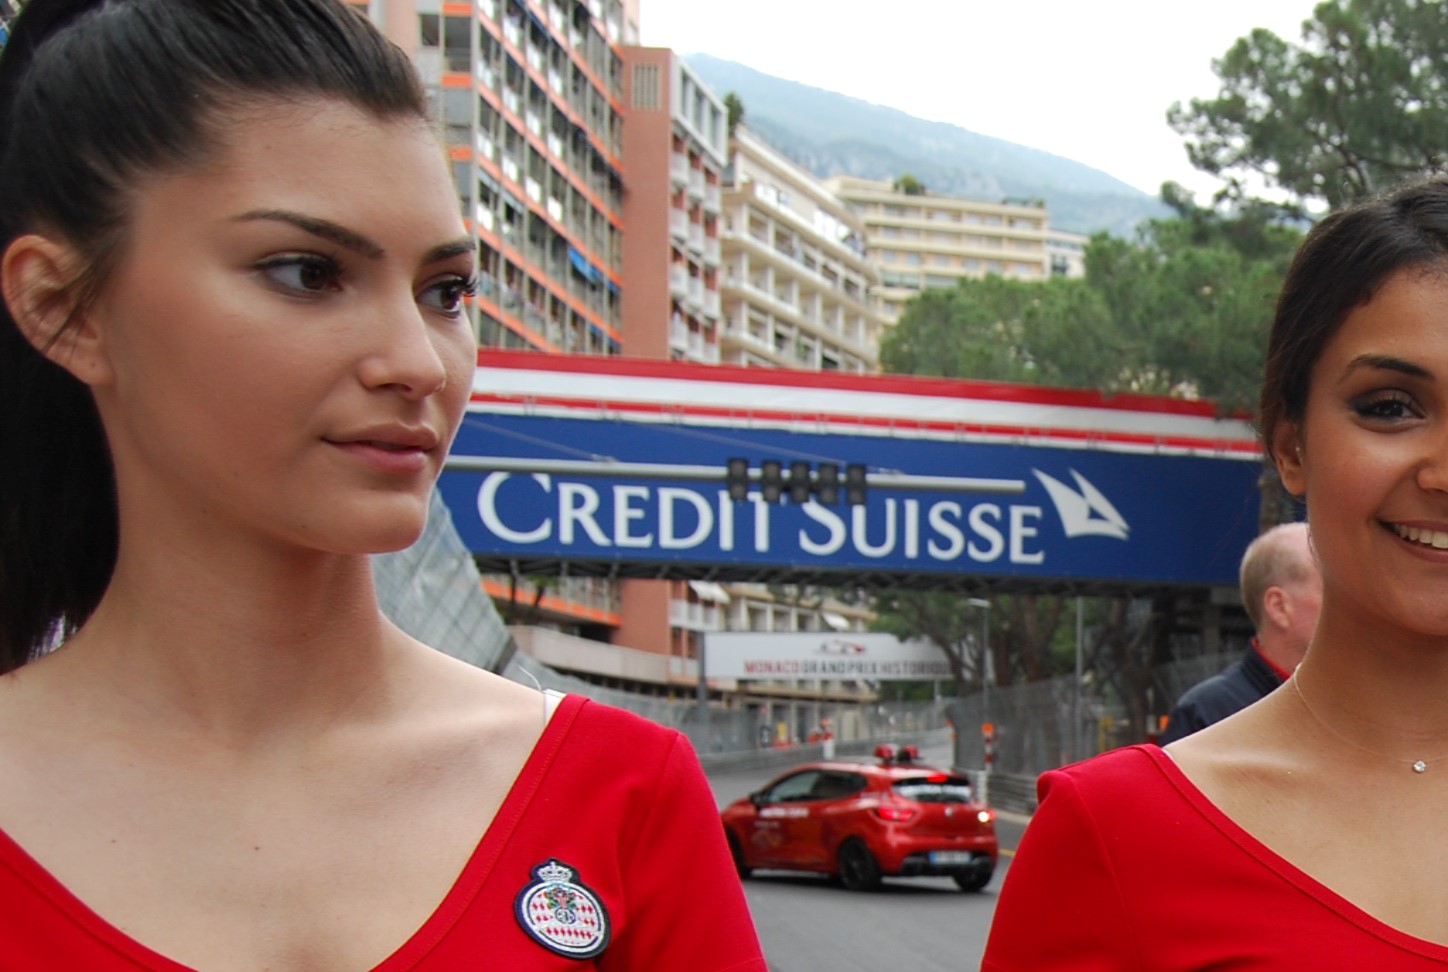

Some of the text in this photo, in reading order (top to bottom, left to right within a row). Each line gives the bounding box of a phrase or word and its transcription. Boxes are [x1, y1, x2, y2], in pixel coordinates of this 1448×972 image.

[477, 469, 1046, 565] CREDIT SUISSE
[743, 659, 801, 675] MONACO
[803, 659, 846, 675] GRAND
[881, 660, 956, 677] HISTORIQU
